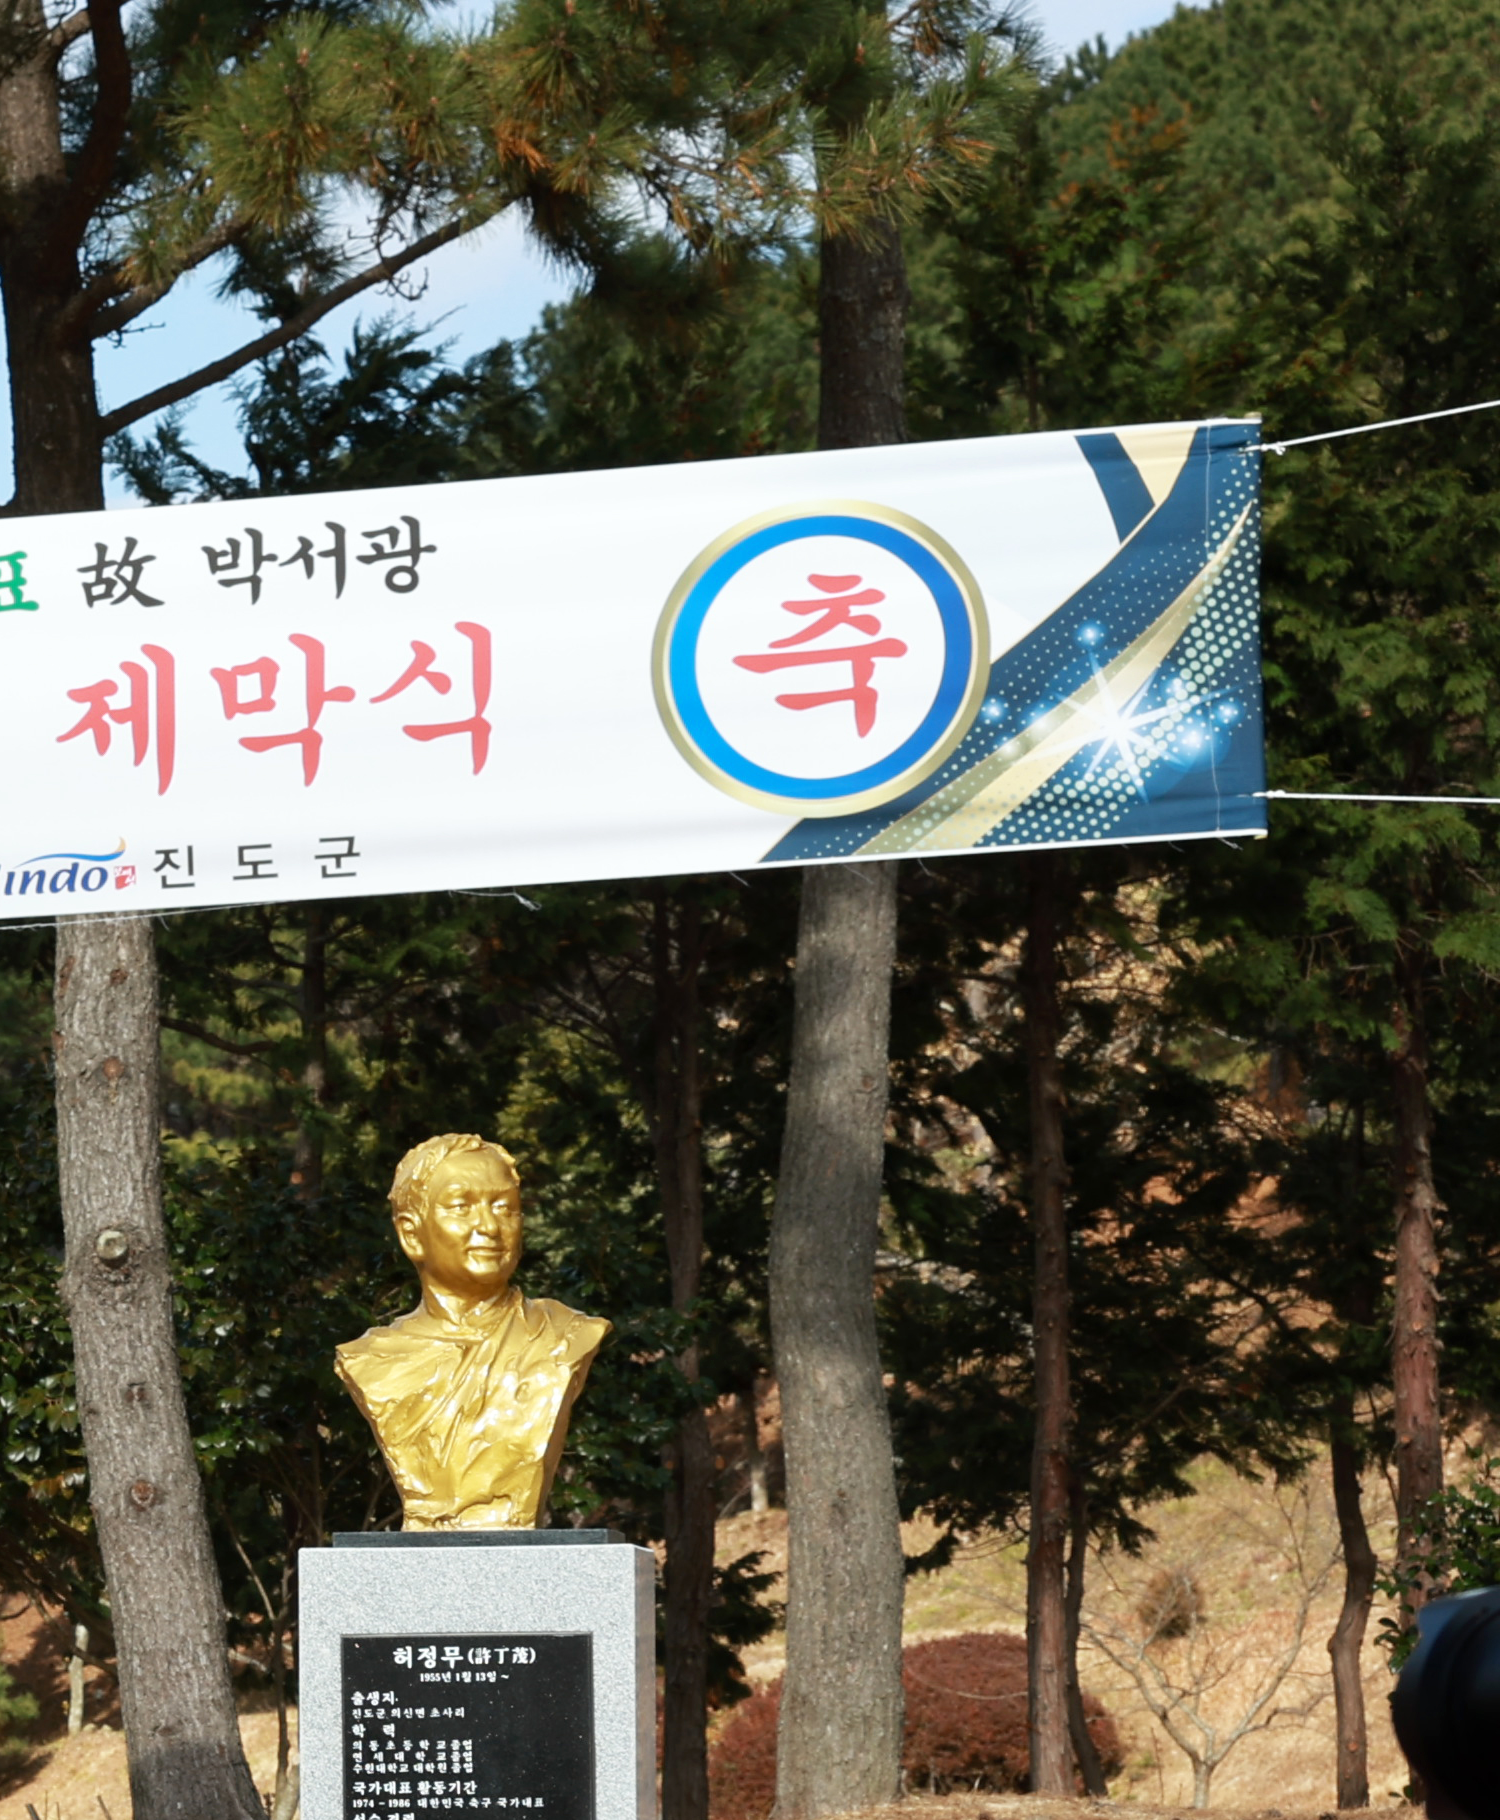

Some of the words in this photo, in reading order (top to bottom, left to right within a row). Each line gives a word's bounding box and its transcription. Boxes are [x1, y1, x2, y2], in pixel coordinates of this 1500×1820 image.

[78, 538, 164, 607] 故
[202, 516, 436, 603] 박서광
[728, 569, 912, 745] 축
[57, 622, 491, 794] 제막식
[420, 1671, 451, 1683] 1955년
[456, 1671, 471, 1683] 1월
[476, 1671, 496, 1682] 13일
[351, 1691, 394, 1706] 출생지
[352, 1708, 385, 1719] 진도군
[391, 1707, 425, 1718] 의신면
[430, 1707, 464, 1718] 초사리
[353, 1781, 412, 1795] 국가대표
[417, 1780, 477, 1795] 활동기간
[353, 1799, 374, 1808] 1974
[389, 1799, 410, 1807] 1986
[417, 1798, 464, 1808] 대한민국
[497, 1797, 544, 1808] 국가대표
